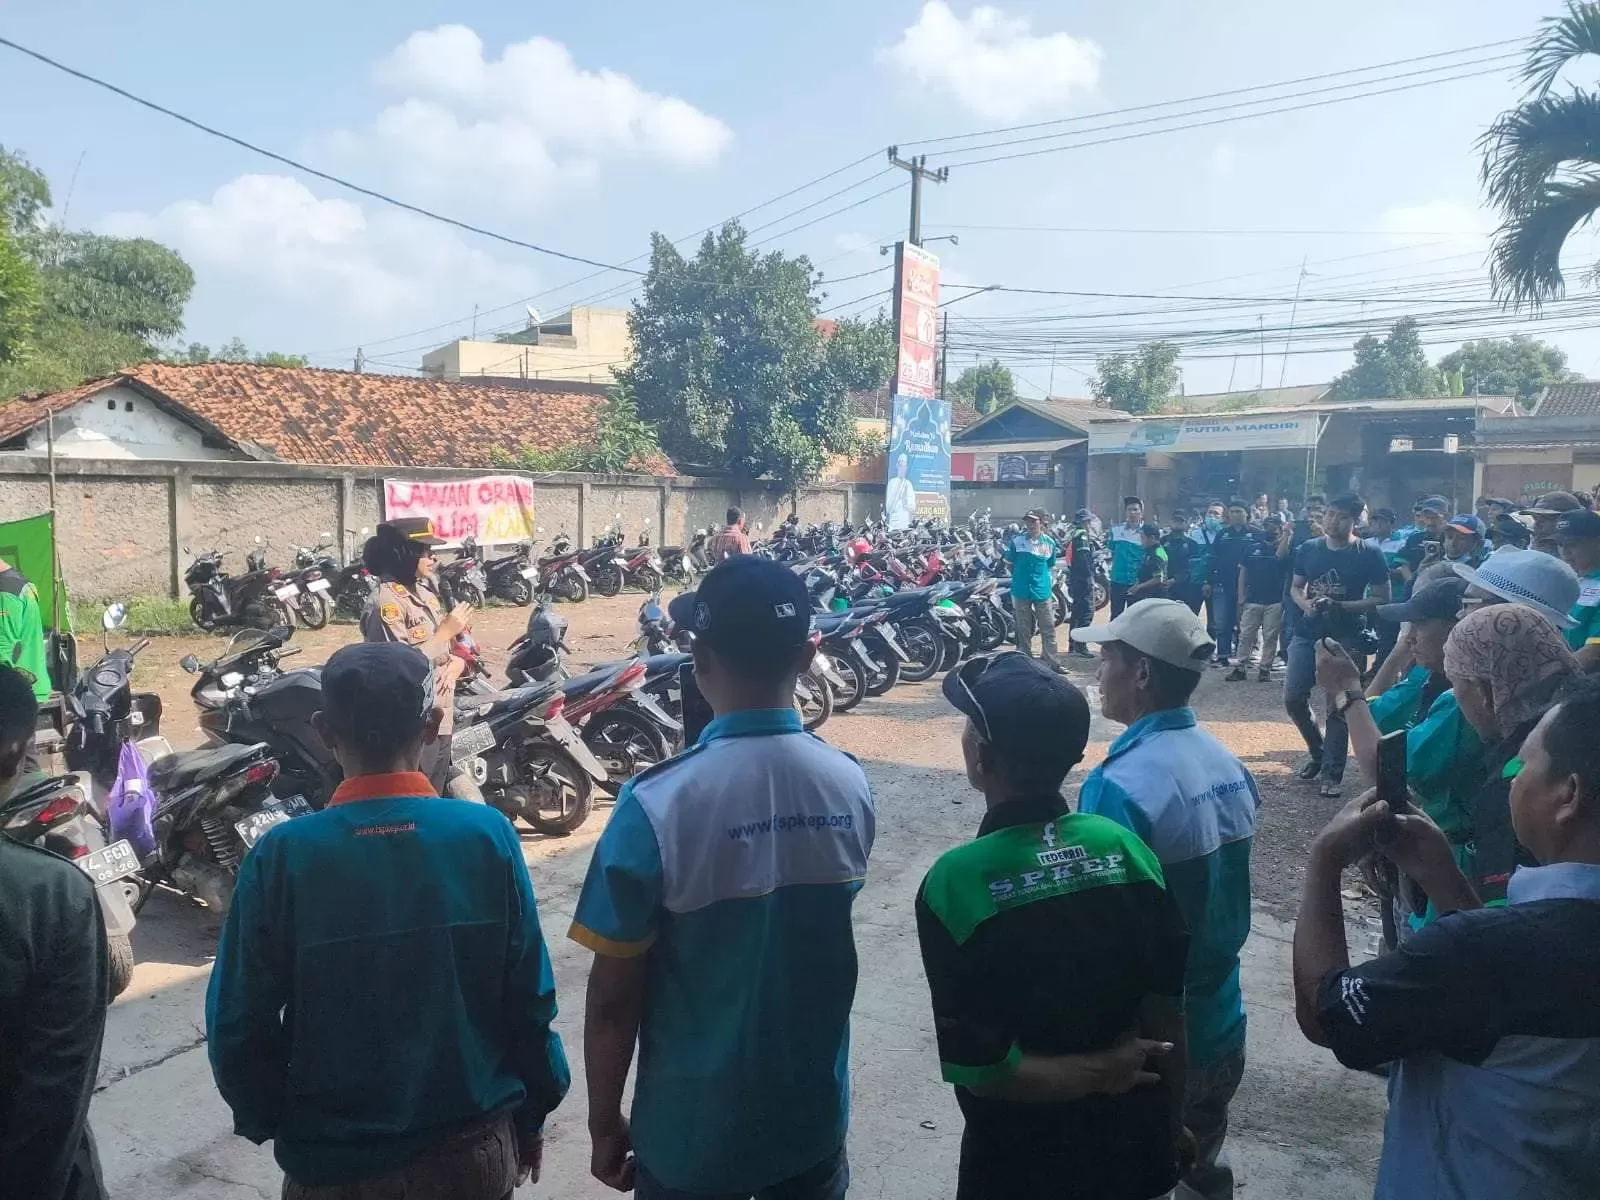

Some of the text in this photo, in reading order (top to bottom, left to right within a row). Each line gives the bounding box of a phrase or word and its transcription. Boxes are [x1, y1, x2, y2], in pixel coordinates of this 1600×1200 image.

[1185, 421, 1299, 434] PUTRA MANDIRI
[389, 481, 471, 507] LAWAN
[728, 814, 852, 840] wwwfspkep.org
[1040, 847, 1084, 864] FEDERASI
[989, 854, 1124, 896] SPKEP
